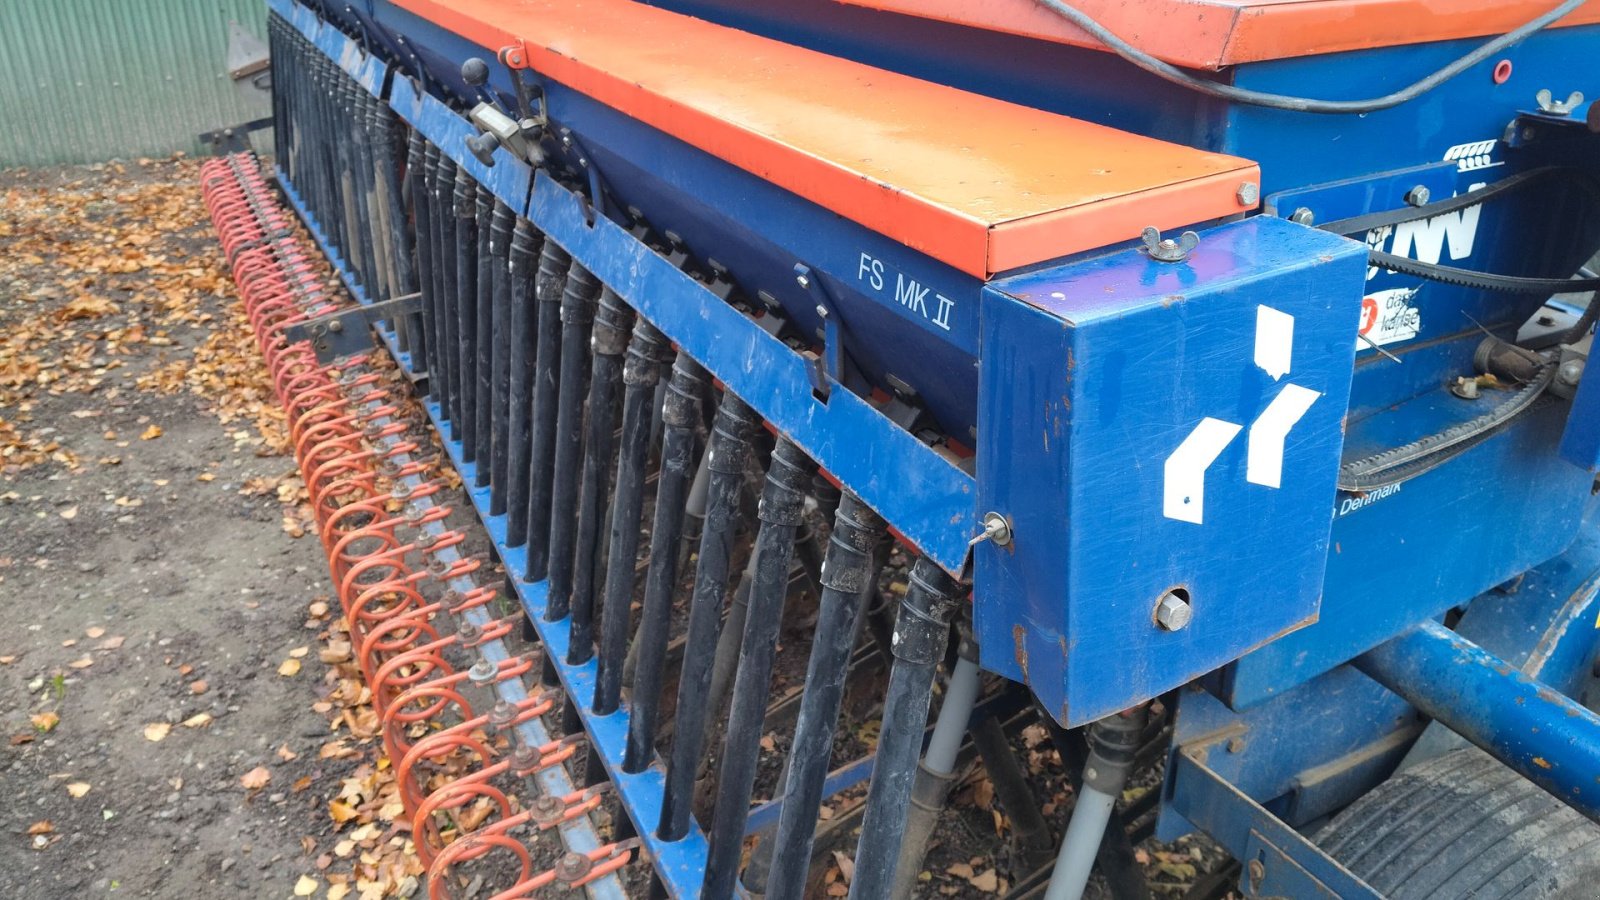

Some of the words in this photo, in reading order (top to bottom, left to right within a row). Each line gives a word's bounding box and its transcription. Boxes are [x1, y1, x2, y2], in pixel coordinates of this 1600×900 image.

[858, 252, 884, 291] FS
[894, 272, 931, 319] MK
[931, 293, 955, 331] II
[1340, 481, 1401, 516] Denmark
